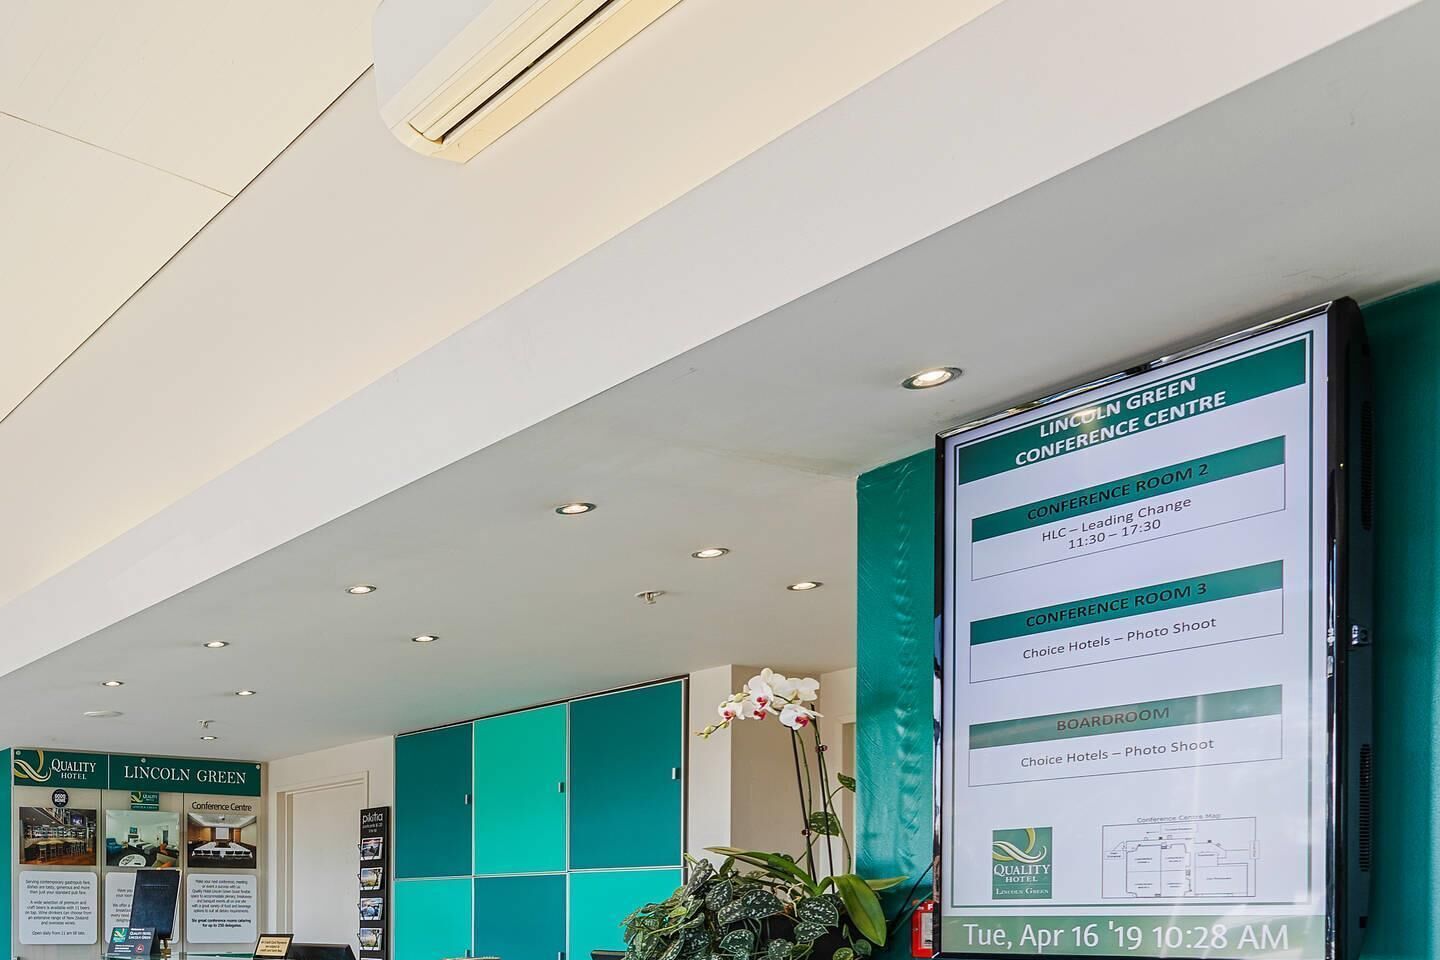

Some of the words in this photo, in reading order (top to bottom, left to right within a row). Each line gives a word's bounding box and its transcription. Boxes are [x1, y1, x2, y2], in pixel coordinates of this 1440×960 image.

[1040, 400, 1121, 438] LINCOLN
[1126, 377, 1196, 412] GREEN
[1015, 419, 1139, 466] CONFERENCE
[1143, 391, 1226, 432] CENTRE
[1027, 484, 1131, 521] CONFERENCE
[1136, 467, 1193, 496] ROOM
[1199, 464, 1209, 477] 2
[1042, 526, 1067, 542] HLC
[1082, 510, 1134, 536] Leading
[1138, 497, 1191, 524] Change
[1068, 533, 1105, 550] 11:30
[1122, 519, 1161, 538] 17:30
[1026, 598, 1129, 628] CONFERENCE
[1134, 585, 1192, 608] ROOM
[1197, 583, 1207, 595] 3
[1023, 643, 1064, 660] Choice
[1069, 635, 1110, 651] Hotels
[1127, 625, 1168, 641] Photo
[1173, 617, 1216, 635] Shoot
[1056, 707, 1169, 731] BOARDROOM
[52, 758, 96, 772] QUALITY
[1021, 753, 1062, 768] Choice
[1067, 748, 1108, 763] Hotels
[1125, 742, 1166, 757] Photo
[1171, 738, 1214, 753] Shoot
[61, 772, 86, 780] HOTEL
[124, 766, 190, 780] LINCOLN
[196, 770, 246, 784] GREEN
[192, 802, 229, 810] Conference
[230, 803, 252, 812] Centre
[994, 864, 1050, 876] QUALITY
[963, 924, 1013, 950] Tue,
[1020, 924, 1064, 953] Apr
[1072, 924, 1099, 948] 16
[1108, 921, 1142, 949] '19
[1152, 924, 1227, 949] 10:28
[1237, 924, 1289, 951] AM
